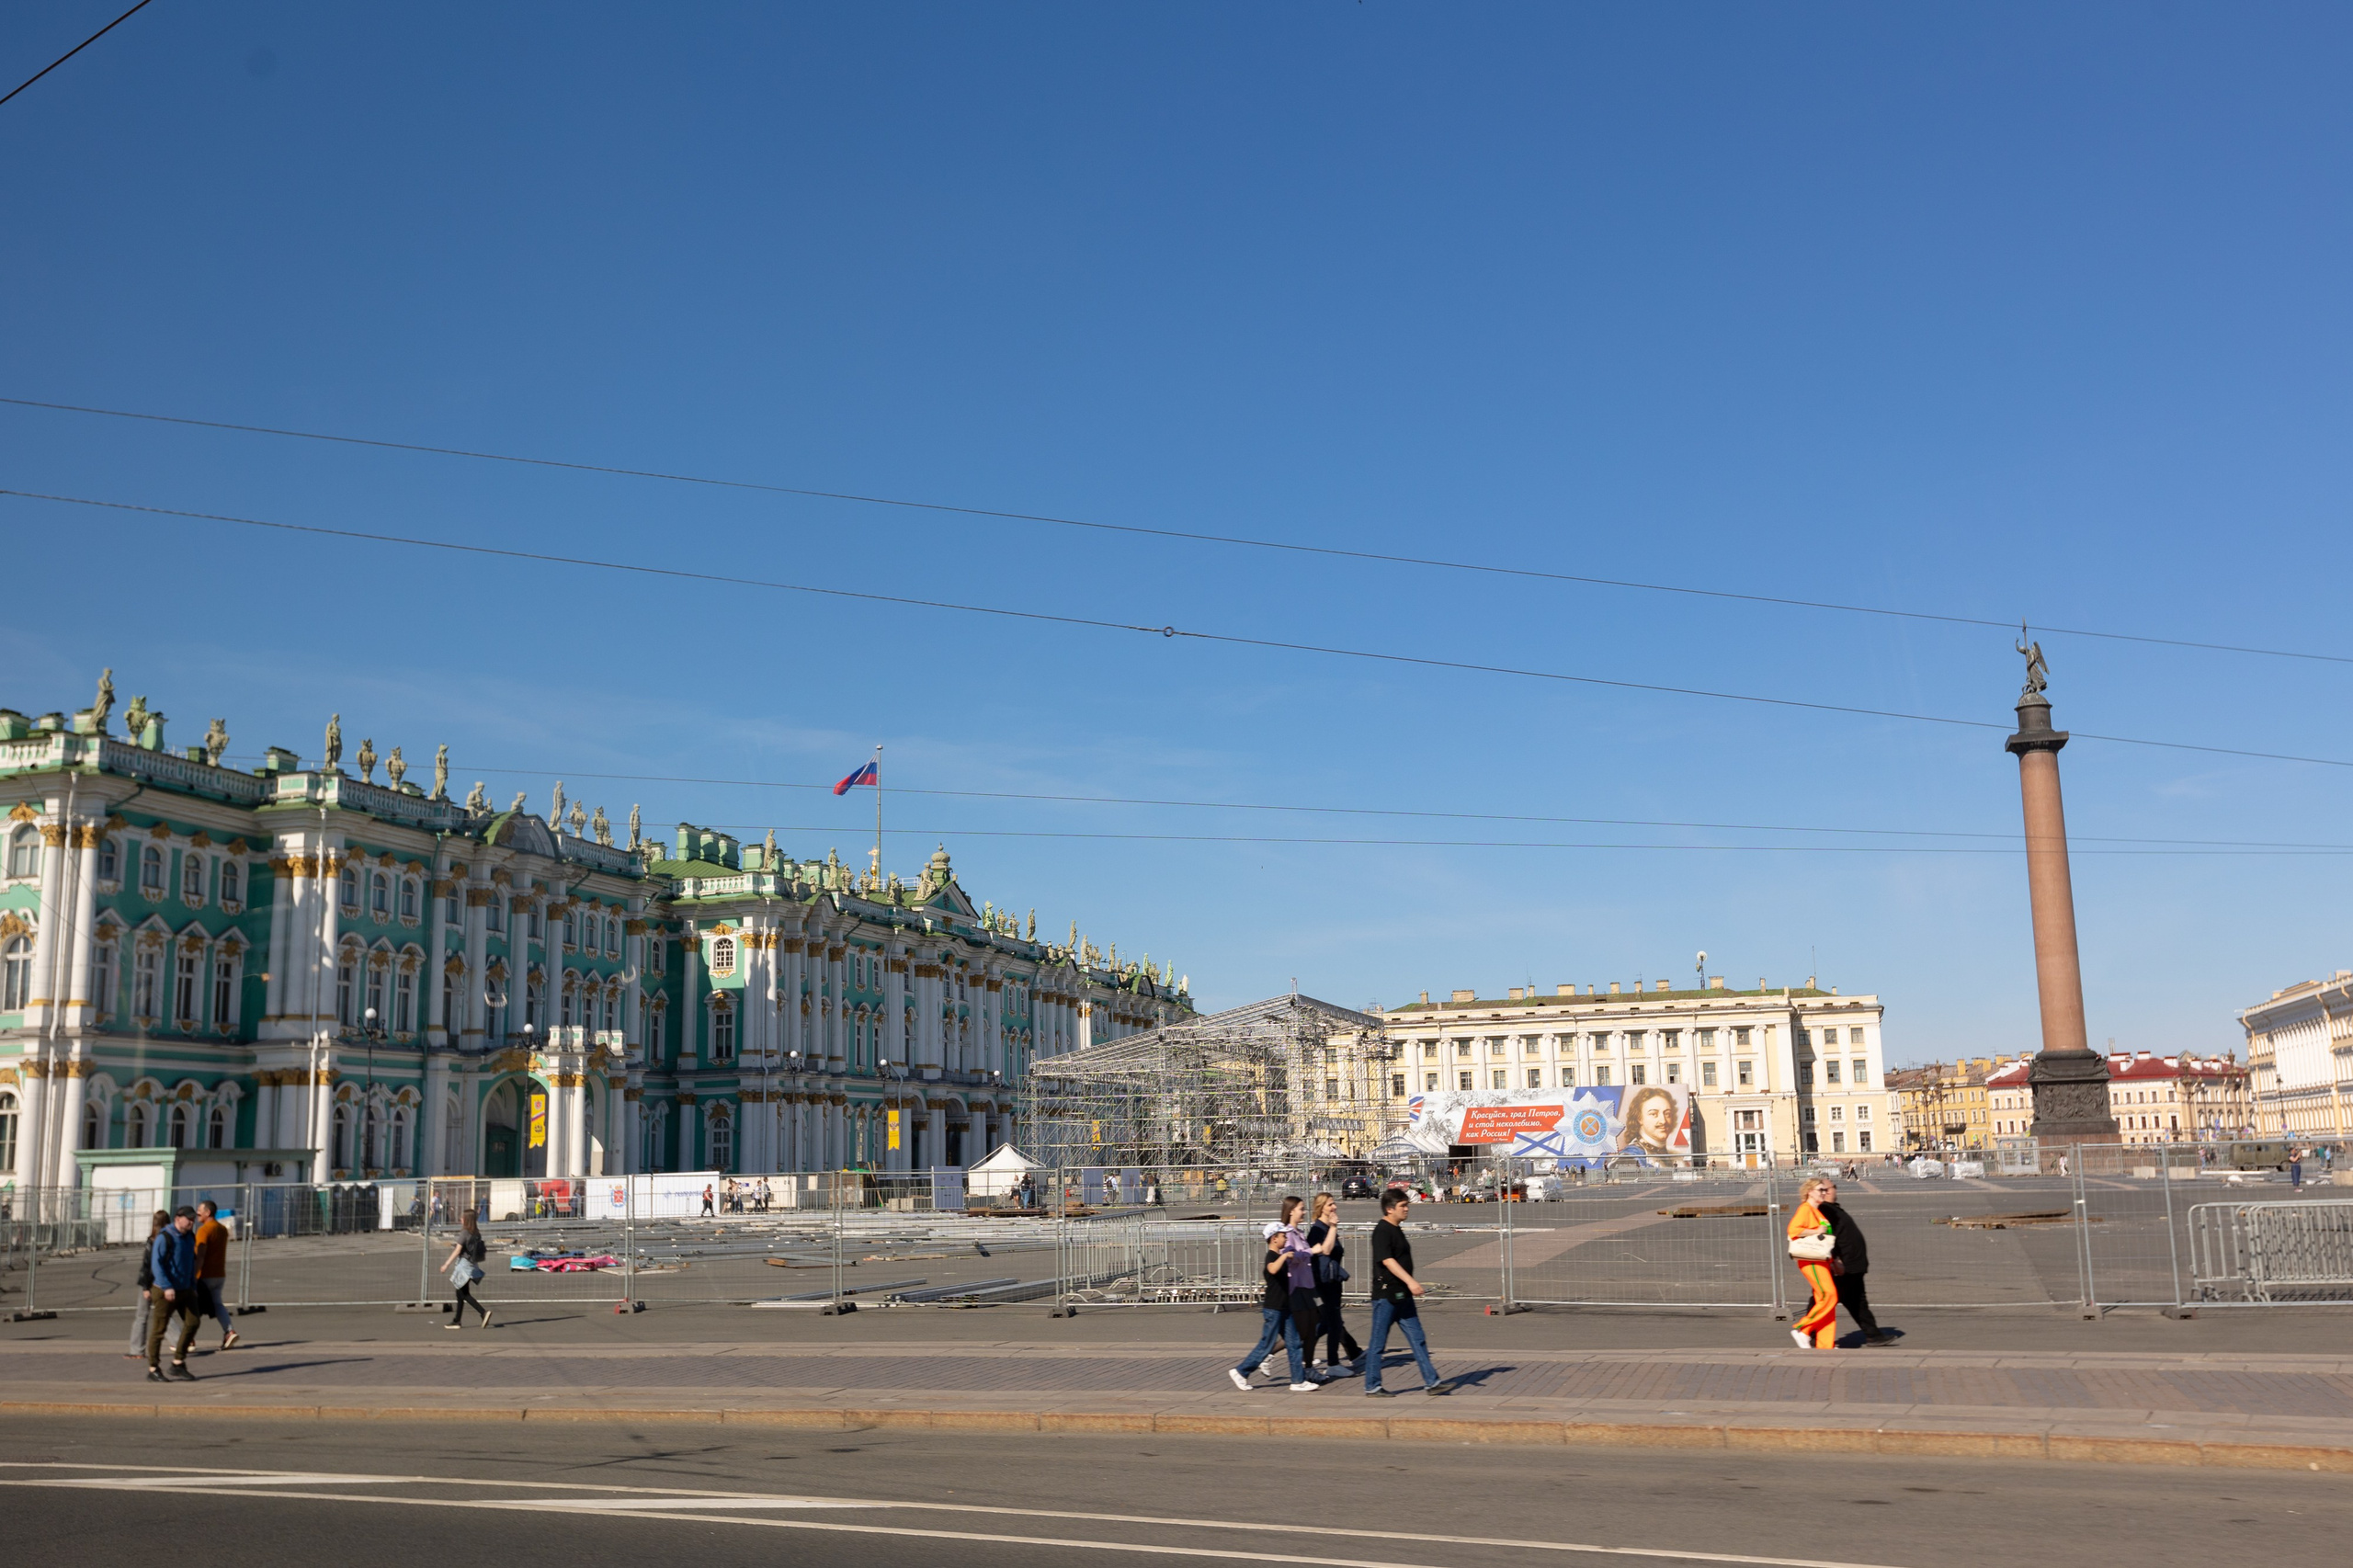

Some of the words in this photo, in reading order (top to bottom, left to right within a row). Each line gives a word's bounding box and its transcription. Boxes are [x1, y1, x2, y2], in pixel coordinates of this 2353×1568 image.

[1471, 1110, 1508, 1119] Красуйся,
[1510, 1111, 1527, 1119] град
[1528, 1108, 1561, 1119] Петров,
[1475, 1119, 1495, 1128] стой
[1481, 1129, 1511, 1137] Россия!
